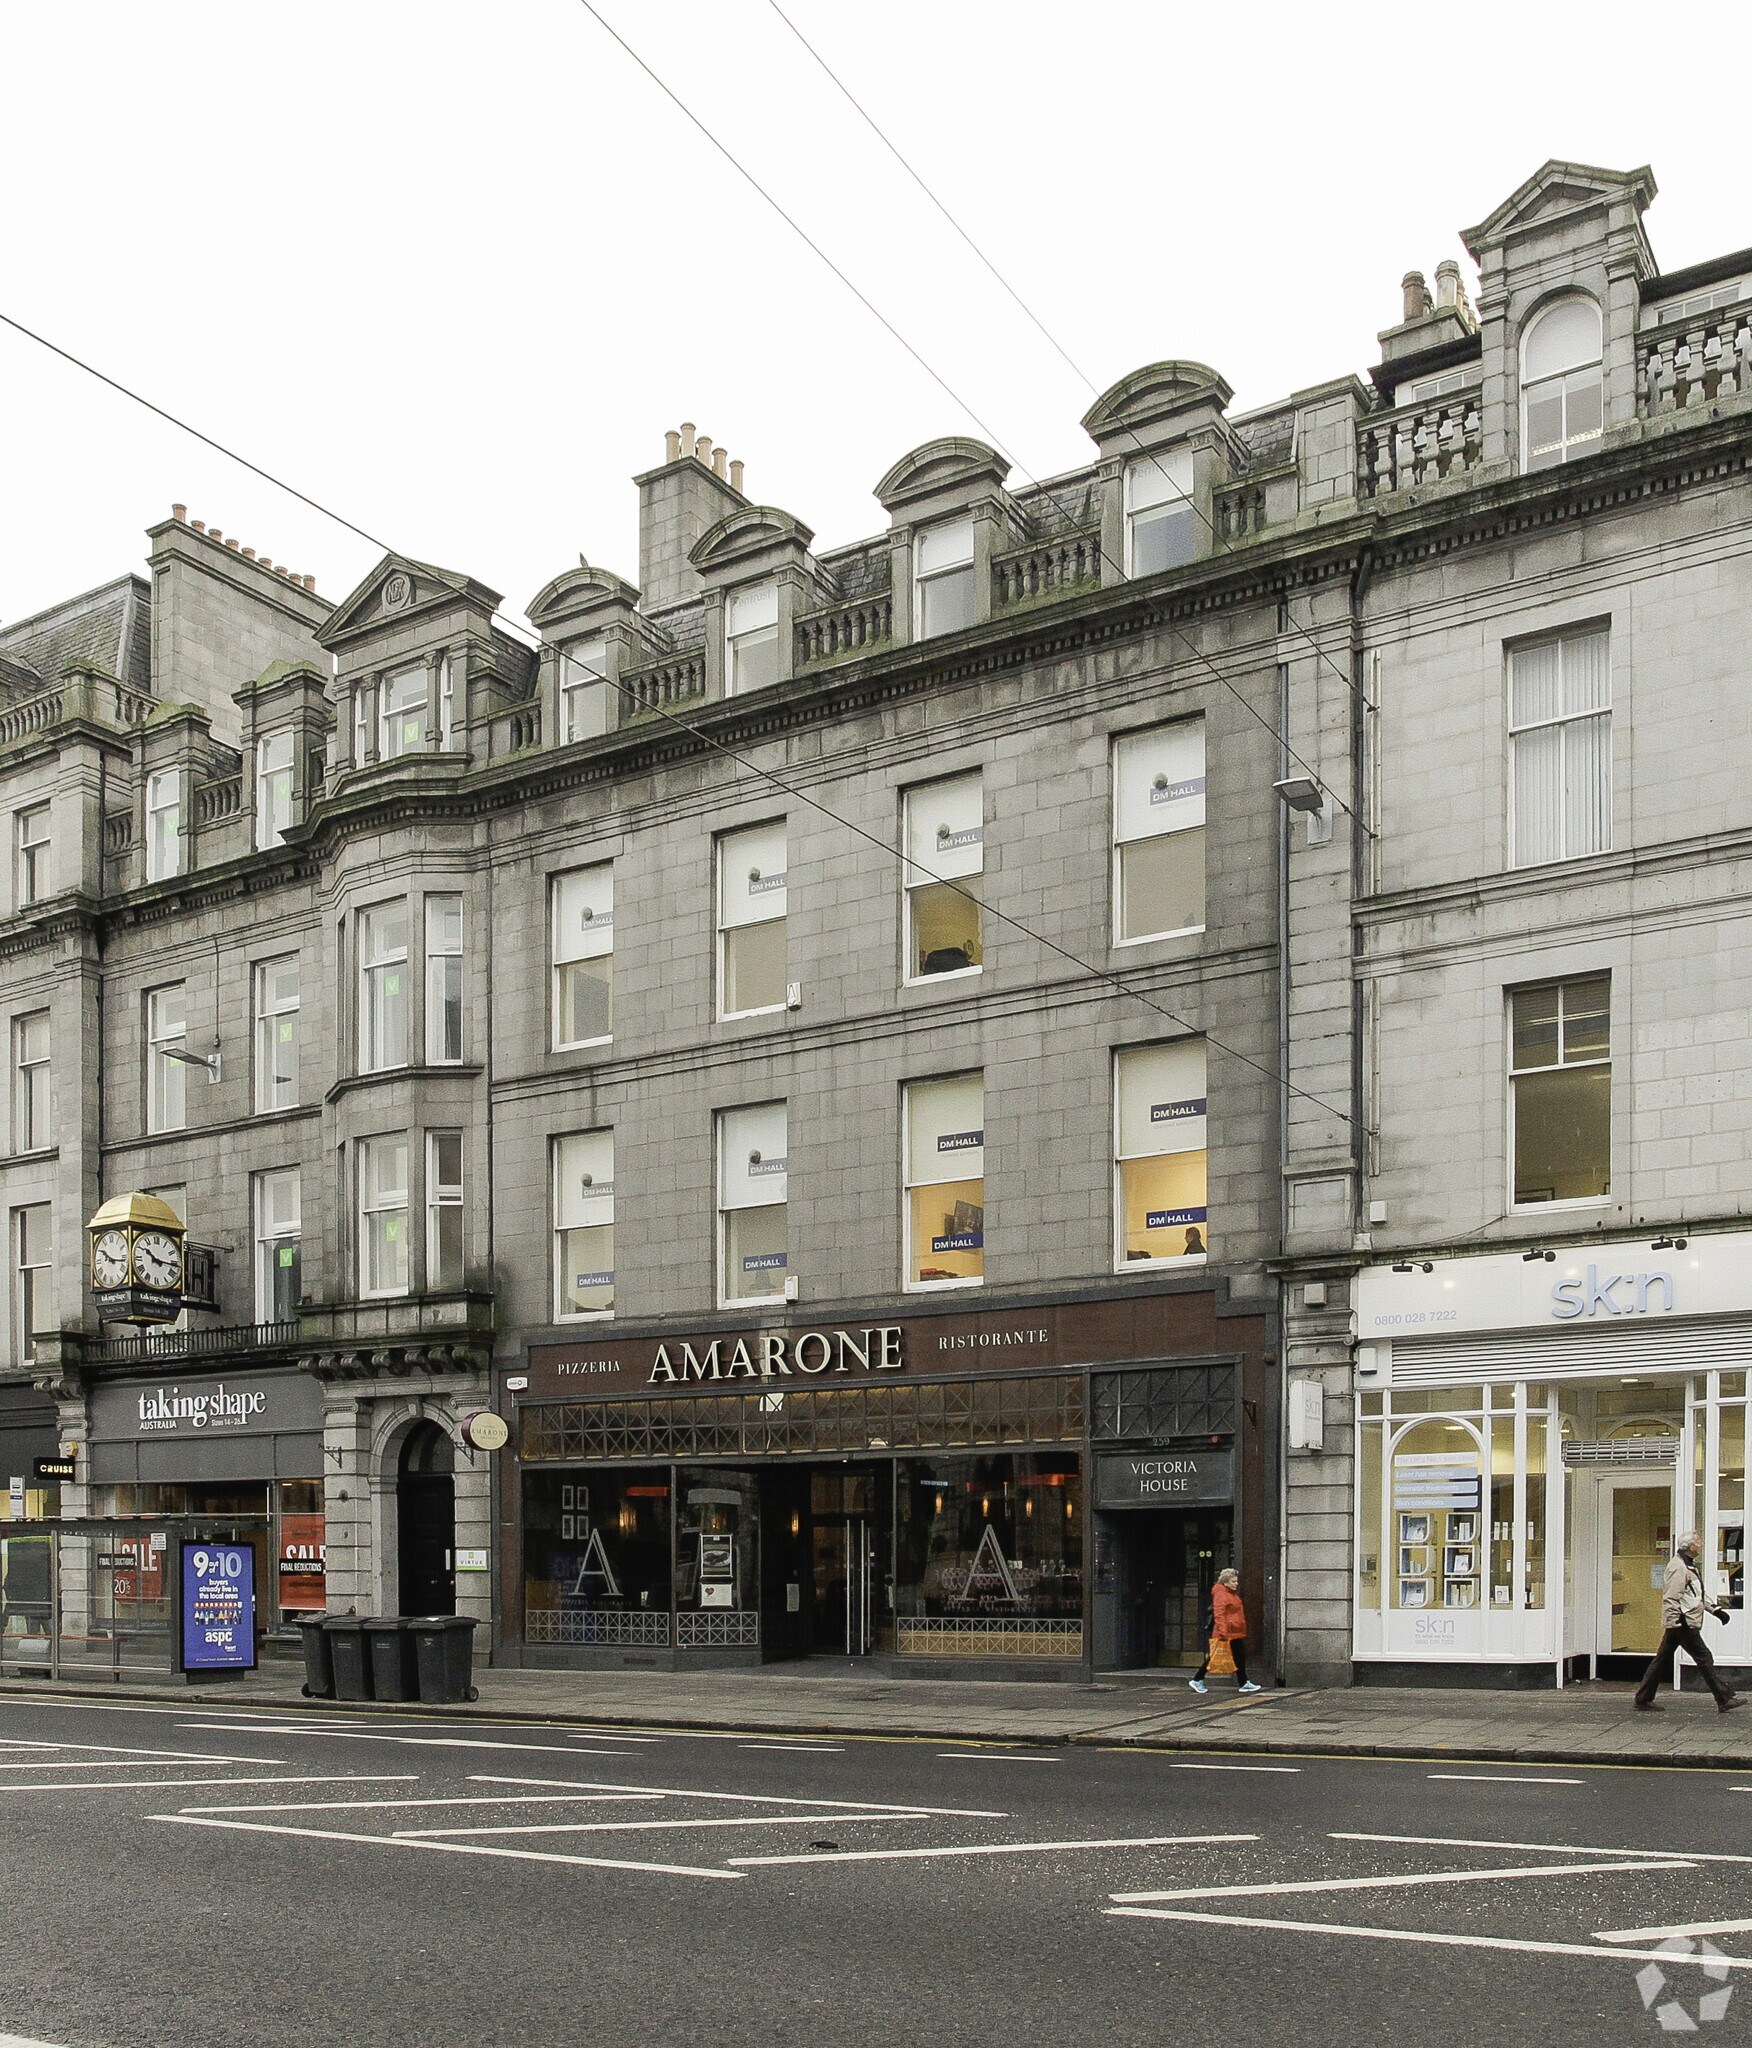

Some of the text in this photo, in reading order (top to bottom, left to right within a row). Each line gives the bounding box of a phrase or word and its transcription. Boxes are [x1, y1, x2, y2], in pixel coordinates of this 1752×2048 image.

[1153, 785, 1196, 801] DM HALL
[939, 834, 977, 849] DM HALL
[765, 879, 785, 889] HALL
[1153, 1105, 1197, 1119] DM HALL
[940, 1137, 978, 1149] DM HALL
[764, 1163, 785, 1172] HALL
[596, 1187, 614, 1195] HALL
[1148, 1213, 1194, 1226] DM HALL
[934, 1238, 974, 1250] DM HALL
[745, 1258, 781, 1270] DM HALL
[579, 1276, 610, 1286] DM HALL
[1374, 1309, 1457, 1326] 0800 028 7222
[938, 1329, 1048, 1350] RISTORANTE
[646, 1326, 902, 1383] AMARONE
[557, 1360, 620, 1375] PIZZERIA
[139, 1420, 177, 1430] AUSTRALIA
[1152, 1437, 1170, 1447] 259
[40, 1464, 74, 1474] CRUISE
[1131, 1460, 1198, 1475] VICTORIA
[1140, 1479, 1188, 1492] HOUSE
[193, 1551, 209, 1578] 9
[216, 1552, 242, 1578] 10
[280, 1562, 322, 1572] FINAL REDUCTIONS
[567, 1528, 624, 1596] A
[956, 1524, 1029, 1601] A
[209, 1578, 229, 1588] buyers
[198, 1585, 220, 1594] already
[221, 1585, 232, 1593] live
[199, 1592, 209, 1600] the
[210, 1592, 224, 1600] local
[205, 1631, 233, 1647] aspc
